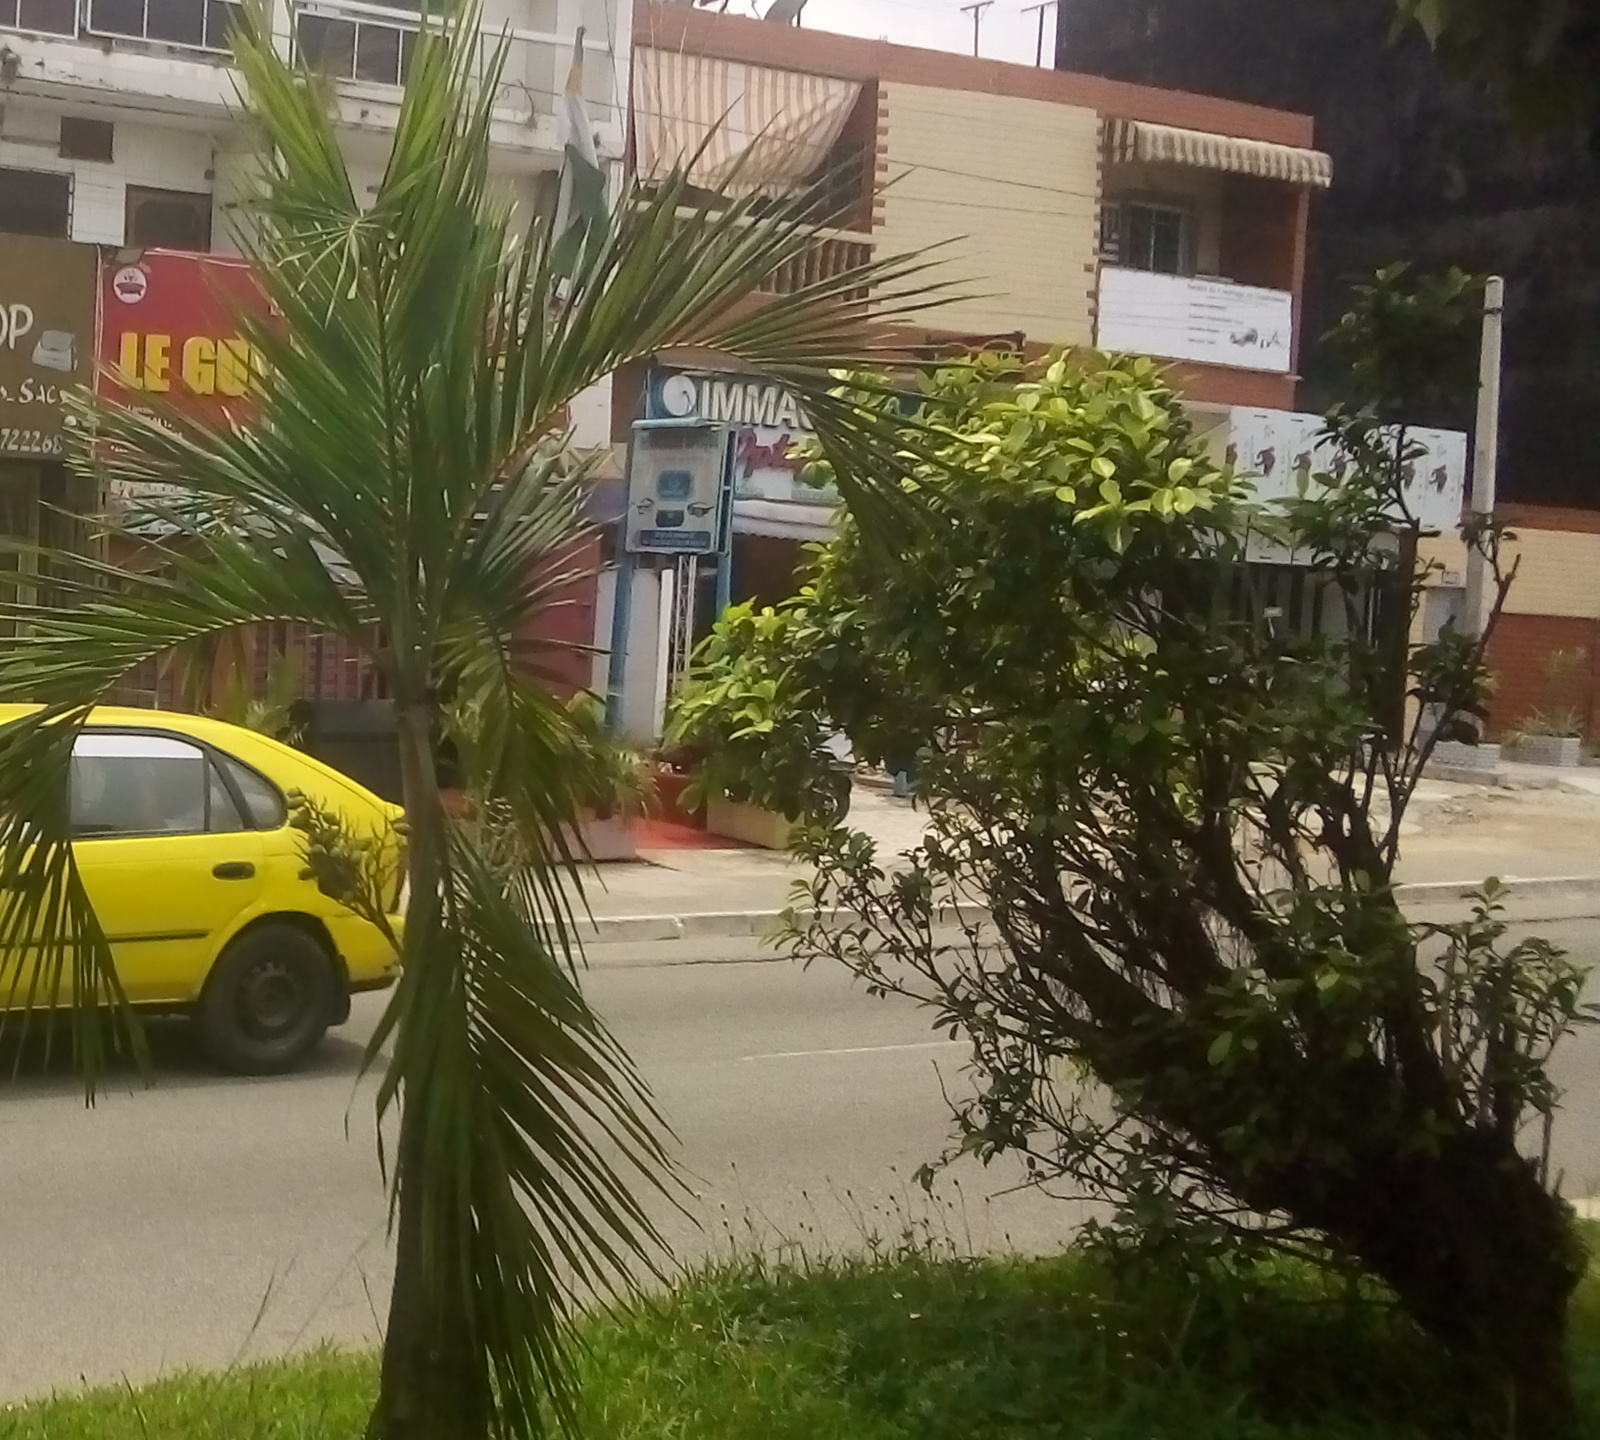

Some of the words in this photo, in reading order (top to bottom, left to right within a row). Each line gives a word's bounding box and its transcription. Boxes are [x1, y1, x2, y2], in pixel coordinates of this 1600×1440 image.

[120, 332, 171, 392] LE
[182, 336, 252, 398] GU
[701, 379, 814, 431] IMMA
